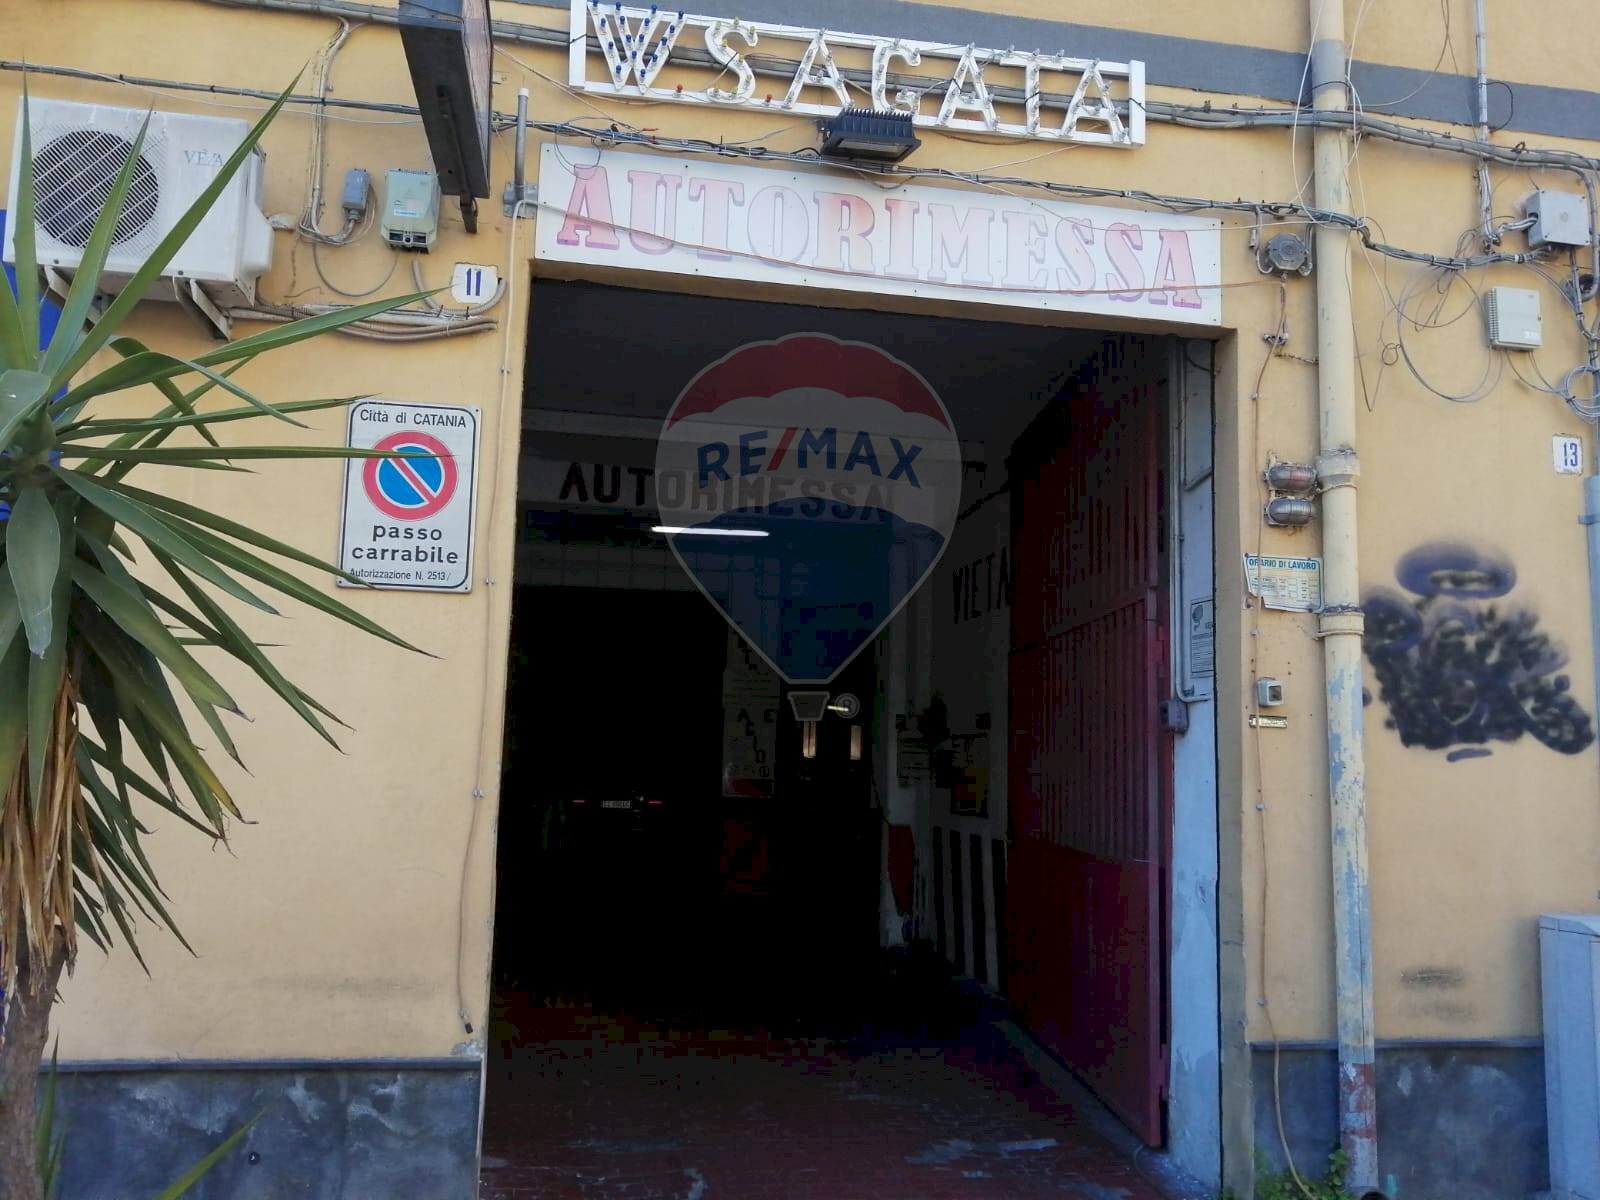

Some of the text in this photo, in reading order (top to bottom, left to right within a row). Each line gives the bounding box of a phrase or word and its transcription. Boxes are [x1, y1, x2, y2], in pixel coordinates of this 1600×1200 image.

[556, 163, 1203, 310] AUTORIMESSA
[466, 268, 482, 297] 11
[360, 409, 466, 428] Città di CATANIA
[1563, 441, 1578, 467] 13
[372, 525, 443, 542] passo
[352, 546, 458, 564] carrabile
[1288, 561, 1317, 570] LAVORO
